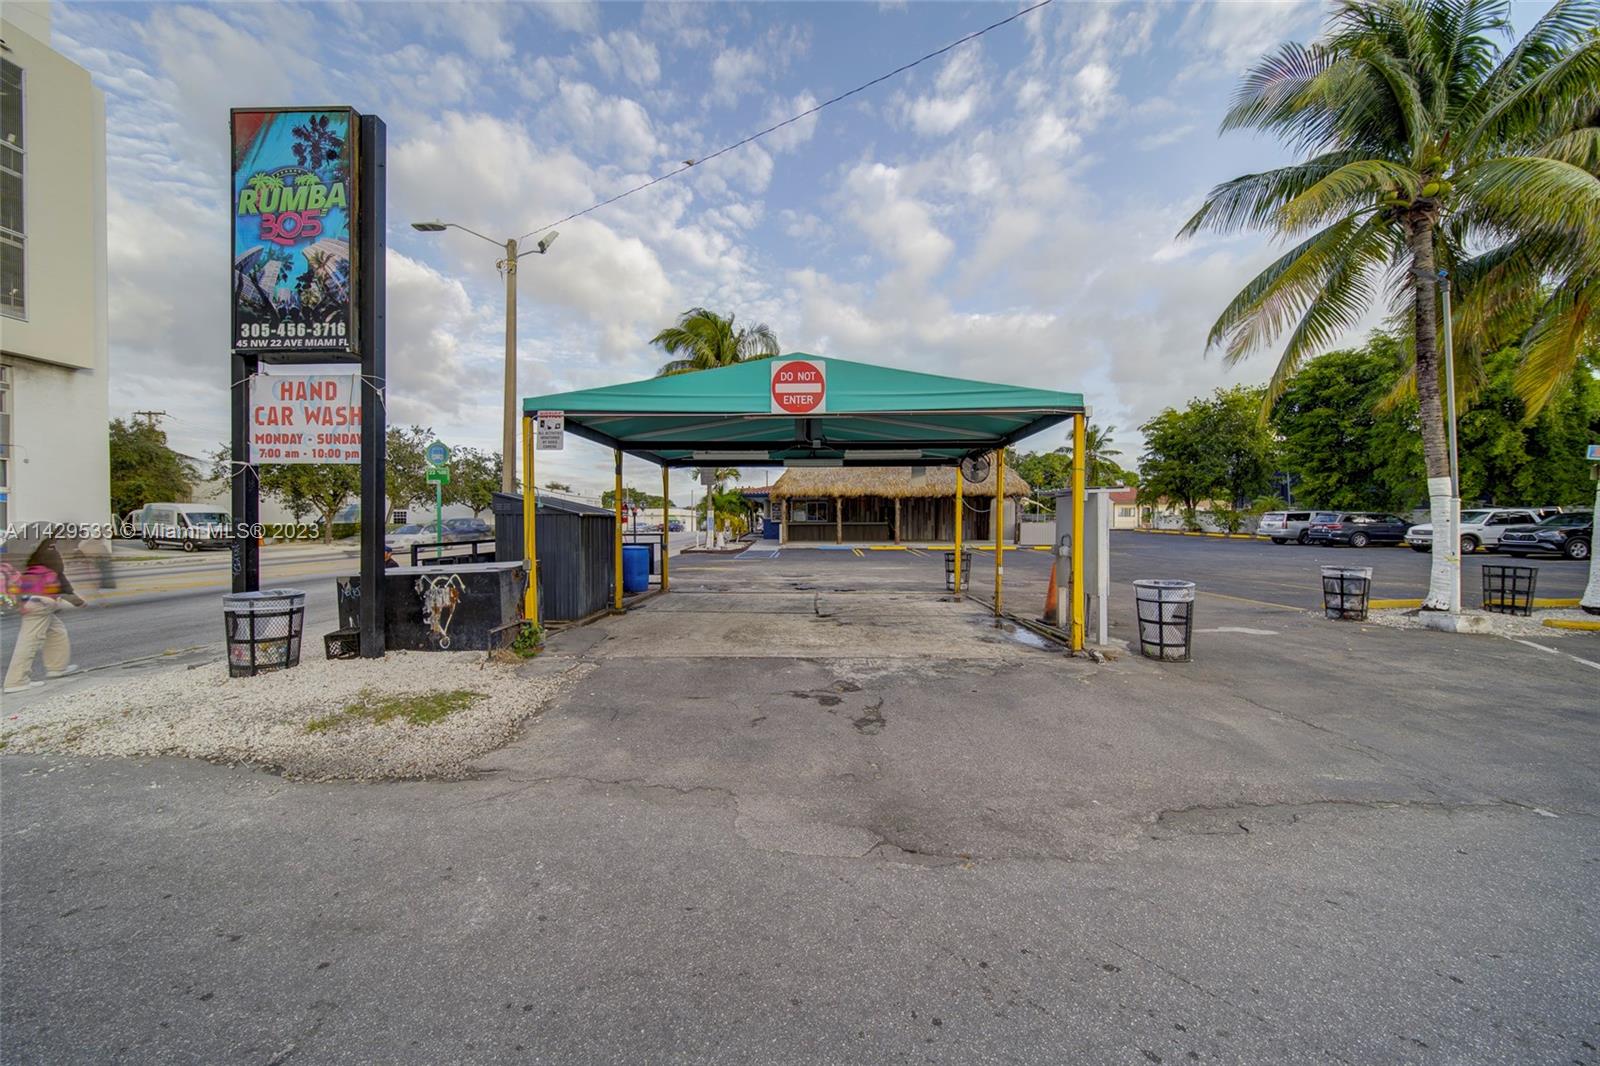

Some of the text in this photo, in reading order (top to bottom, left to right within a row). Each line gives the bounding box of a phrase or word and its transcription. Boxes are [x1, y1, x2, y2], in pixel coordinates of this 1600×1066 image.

[239, 182, 347, 215] RUMBA
[261, 210, 323, 240] 305
[241, 322, 346, 338] 305-456-3716
[236, 340, 248, 348] 45
[270, 339, 282, 347] 22
[284, 339, 303, 347] AVE
[305, 339, 336, 347] MIAMI
[339, 338, 349, 346] FL
[780, 372, 816, 381] DO NOT
[281, 381, 337, 401] HAND
[783, 395, 814, 405] ENTER
[254, 406, 362, 426] CAR WASH
[255, 433, 304, 445] MONDAY
[317, 433, 362, 445] SUNDAY
[259, 448, 281, 458] 7:00
[285, 450, 299, 458] am
[312, 448, 341, 458] 10:00
[345, 450, 360, 460] pm
